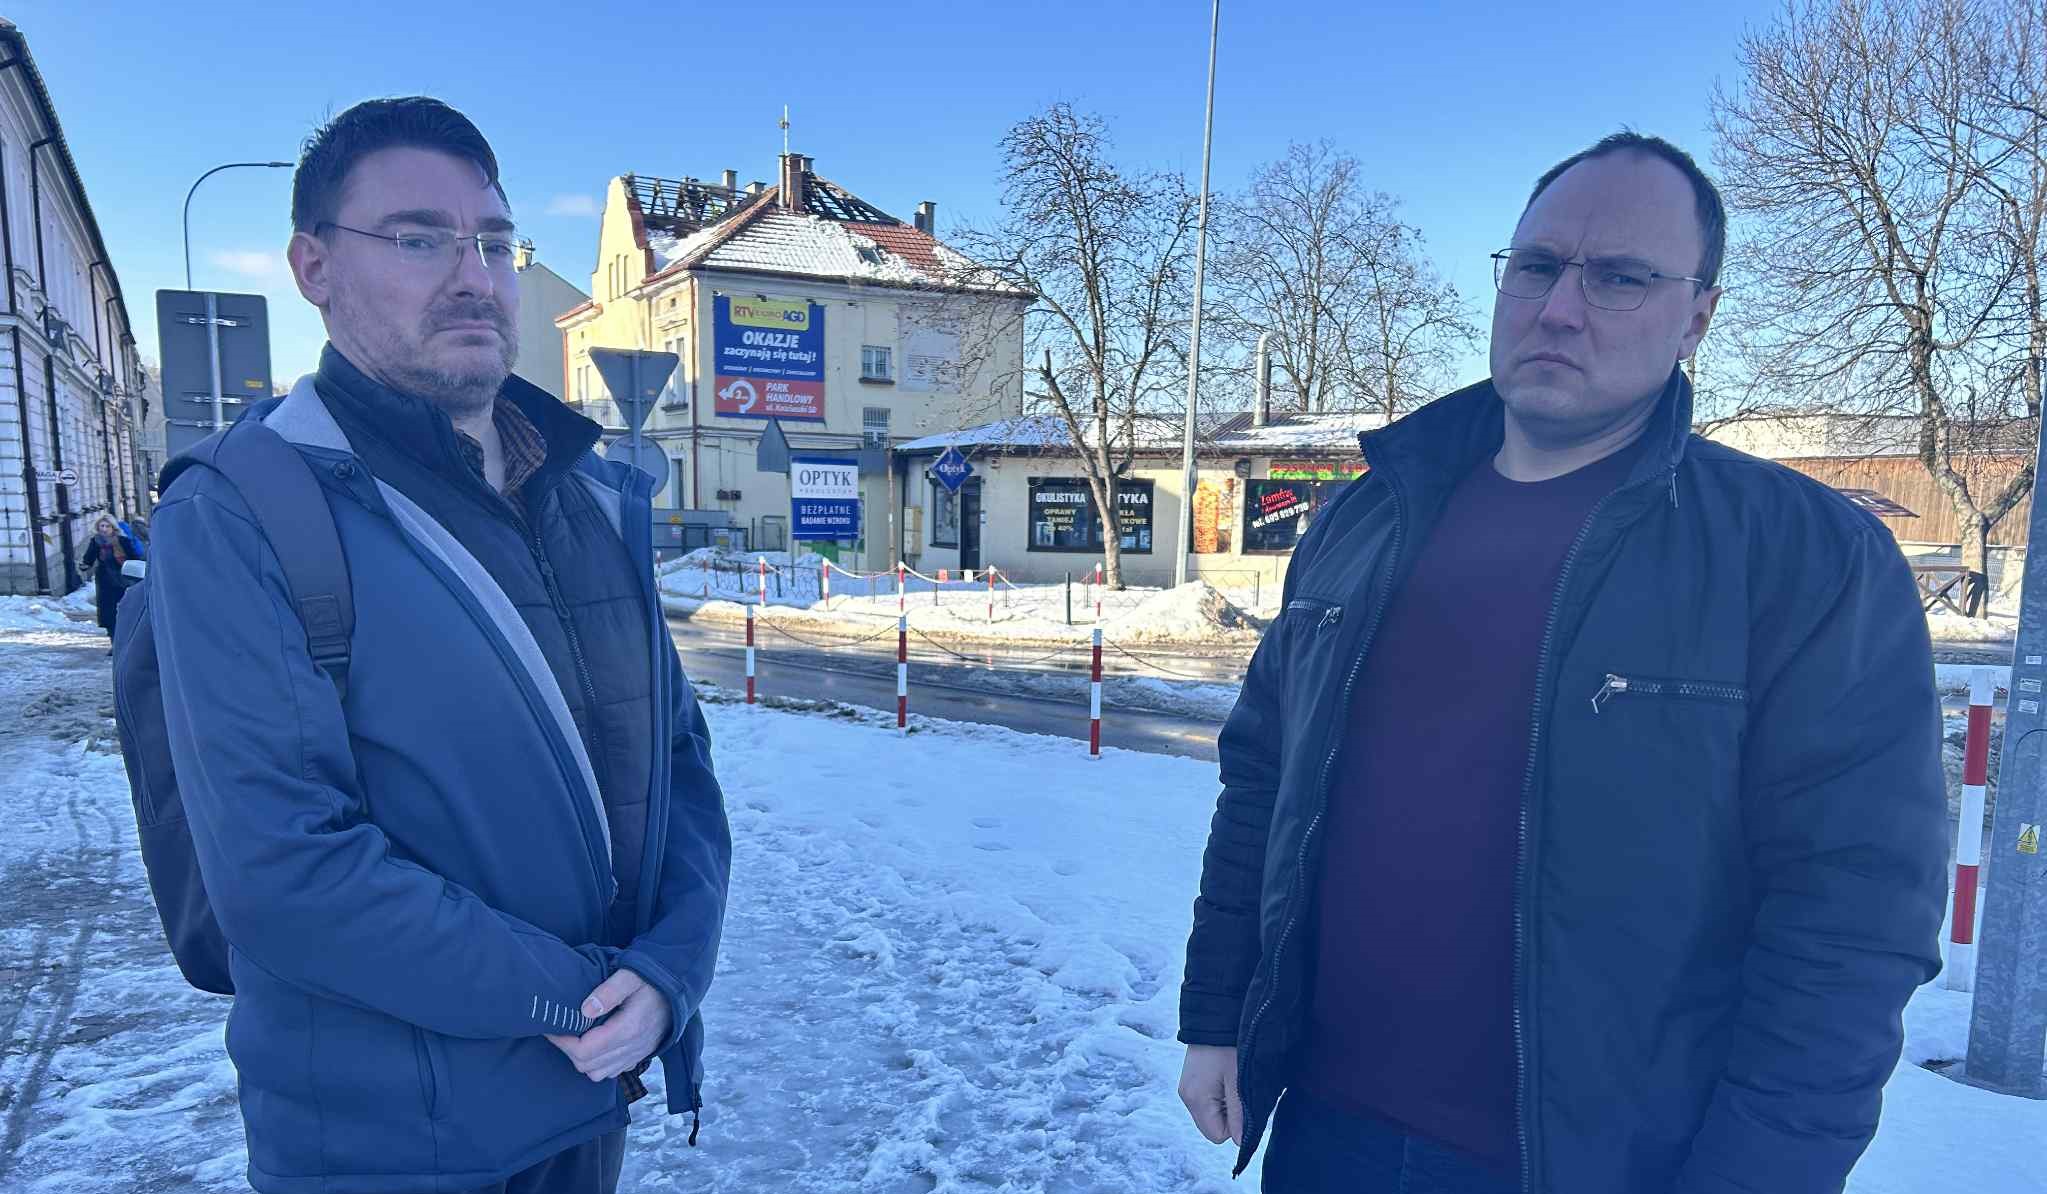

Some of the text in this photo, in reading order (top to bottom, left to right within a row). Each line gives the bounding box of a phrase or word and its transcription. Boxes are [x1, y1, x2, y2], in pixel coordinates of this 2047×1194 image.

[742, 331, 801, 348] OKAZJE
[723, 346, 817, 364] zaczynają się tutaj!
[766, 383, 790, 393] PARK
[766, 392, 815, 404] HANDLOWY
[800, 470, 851, 486] OPTYK
[1036, 492, 1087, 503] OKULISTYKA
[1118, 493, 1148, 504] TYKA
